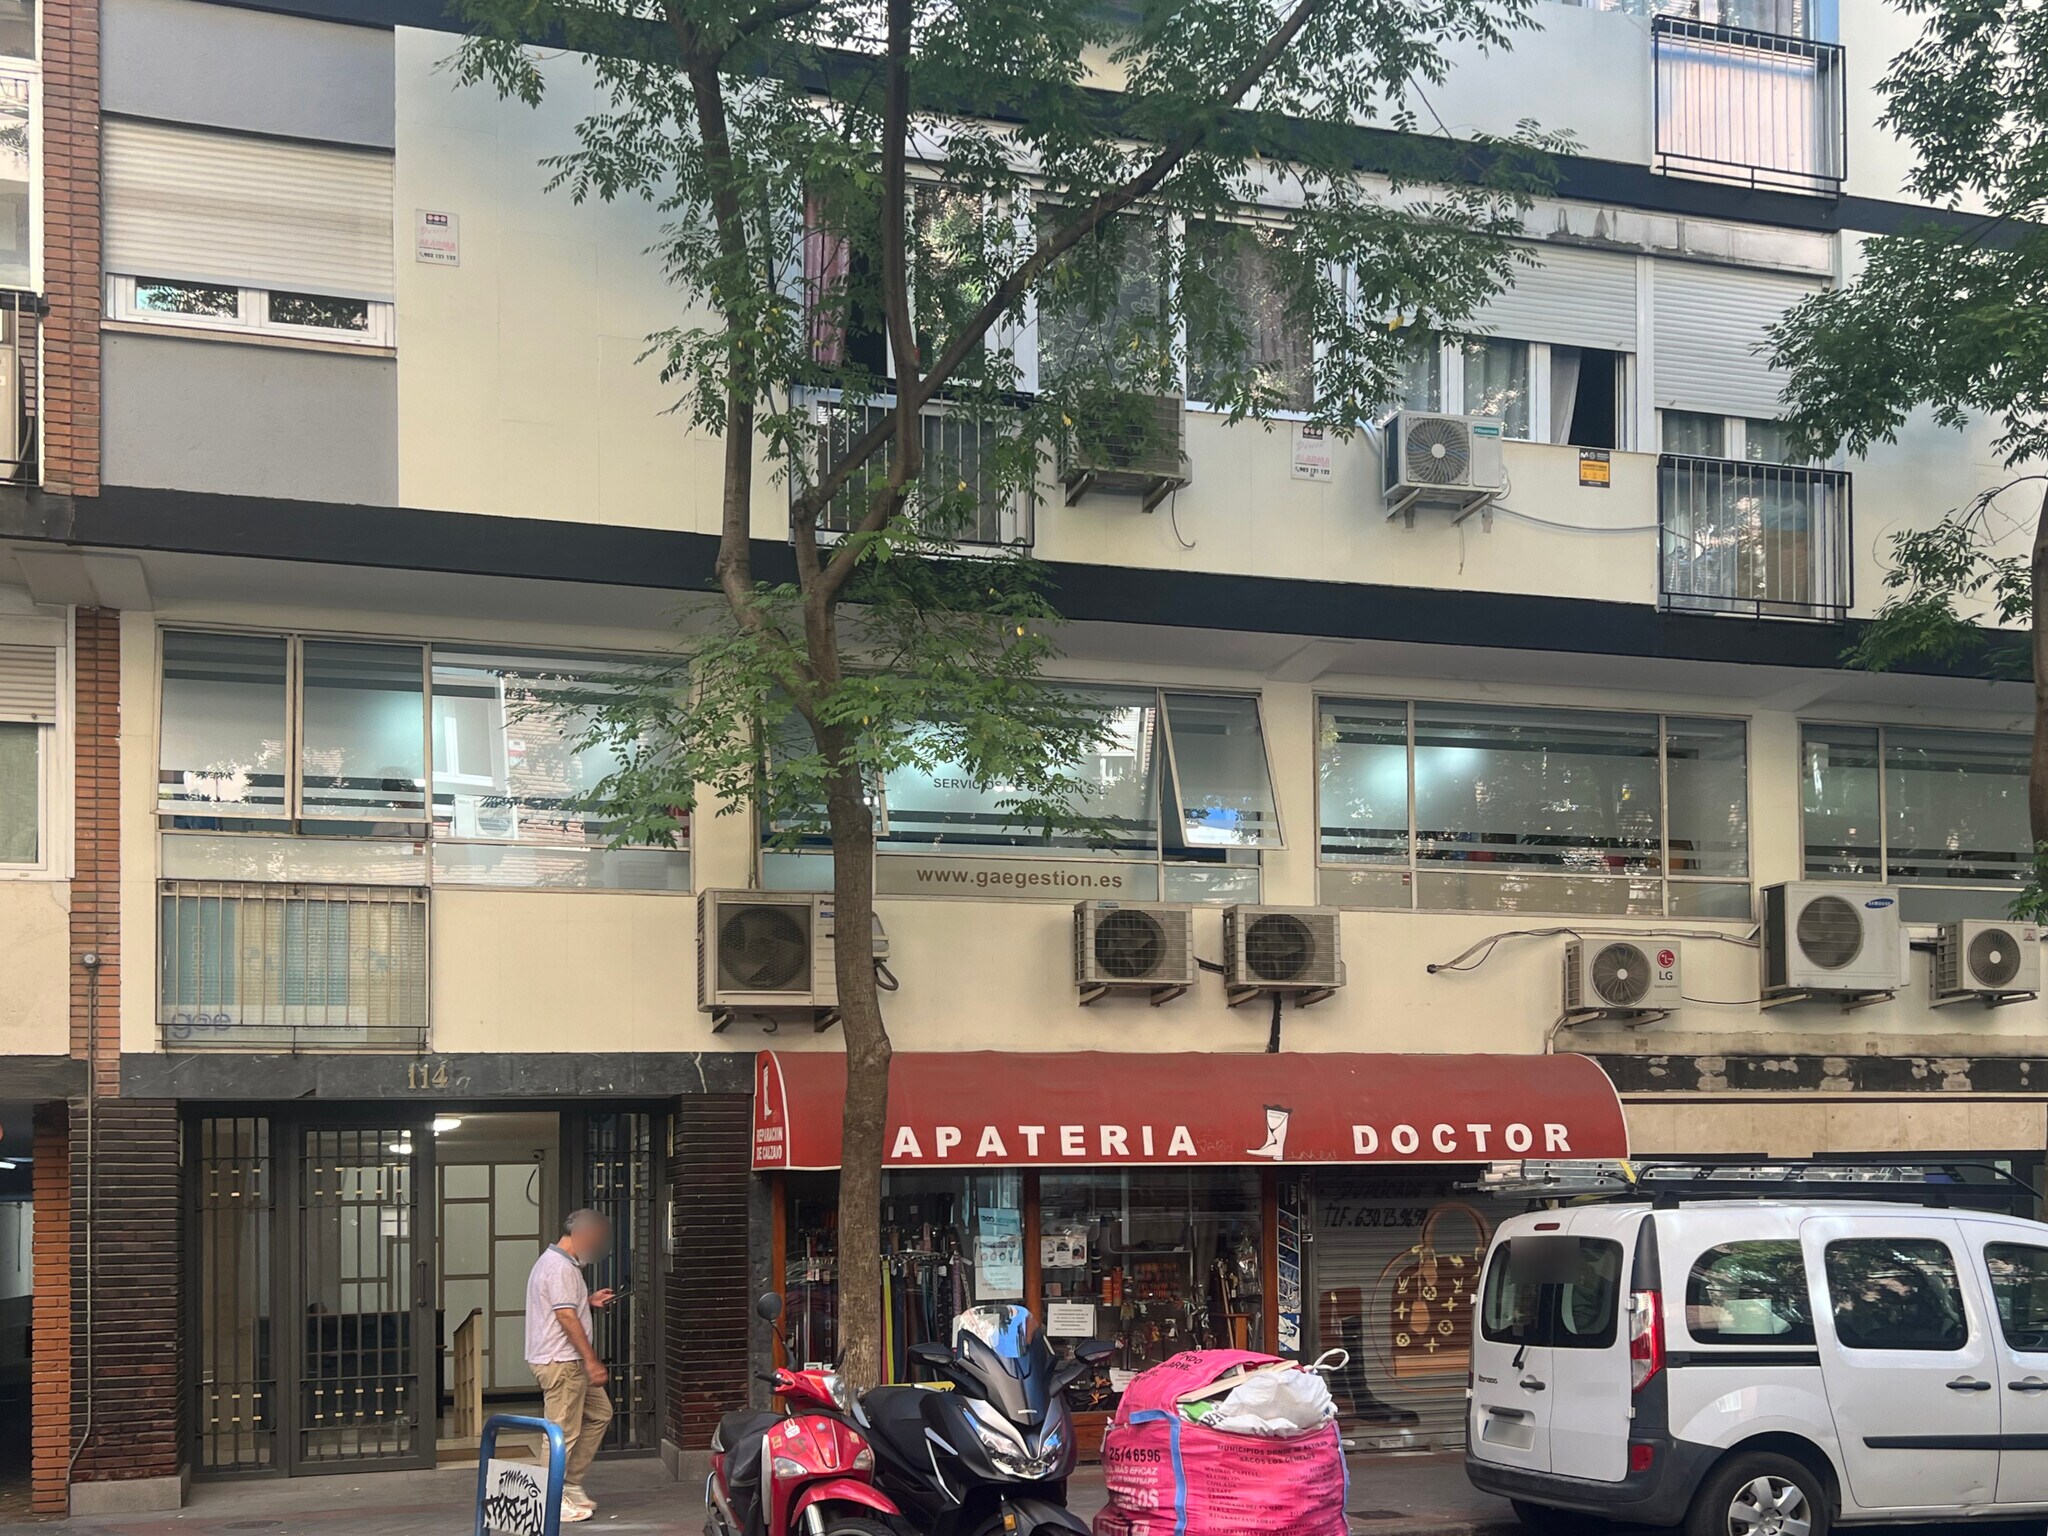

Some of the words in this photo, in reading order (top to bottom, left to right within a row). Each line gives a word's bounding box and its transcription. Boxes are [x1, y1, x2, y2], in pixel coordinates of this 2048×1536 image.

[933, 777, 1002, 791] SERVICOS
[1029, 781, 1083, 794] GEION
[917, 869, 1122, 888] www.gaegestion.es
[1867, 900, 1893, 908] SAMSUNG
[1659, 971, 1673, 981] LG
[408, 1063, 449, 1089] 114
[890, 1125, 1198, 1158] APATERIA
[1352, 1123, 1571, 1155] DOCTOR
[756, 1146, 763, 1160] DE
[763, 1144, 783, 1160] CALZADO
[1109, 1446, 1161, 1463] 25/46596
[1217, 1443, 1264, 1456] MUNICIPIOS
[1240, 1456, 1266, 1464] SACOS
[1129, 1466, 1159, 1476] EFICAZ
[1123, 1476, 1159, 1484] WHATSAPP
[1207, 1481, 1237, 1489] COSLADA
